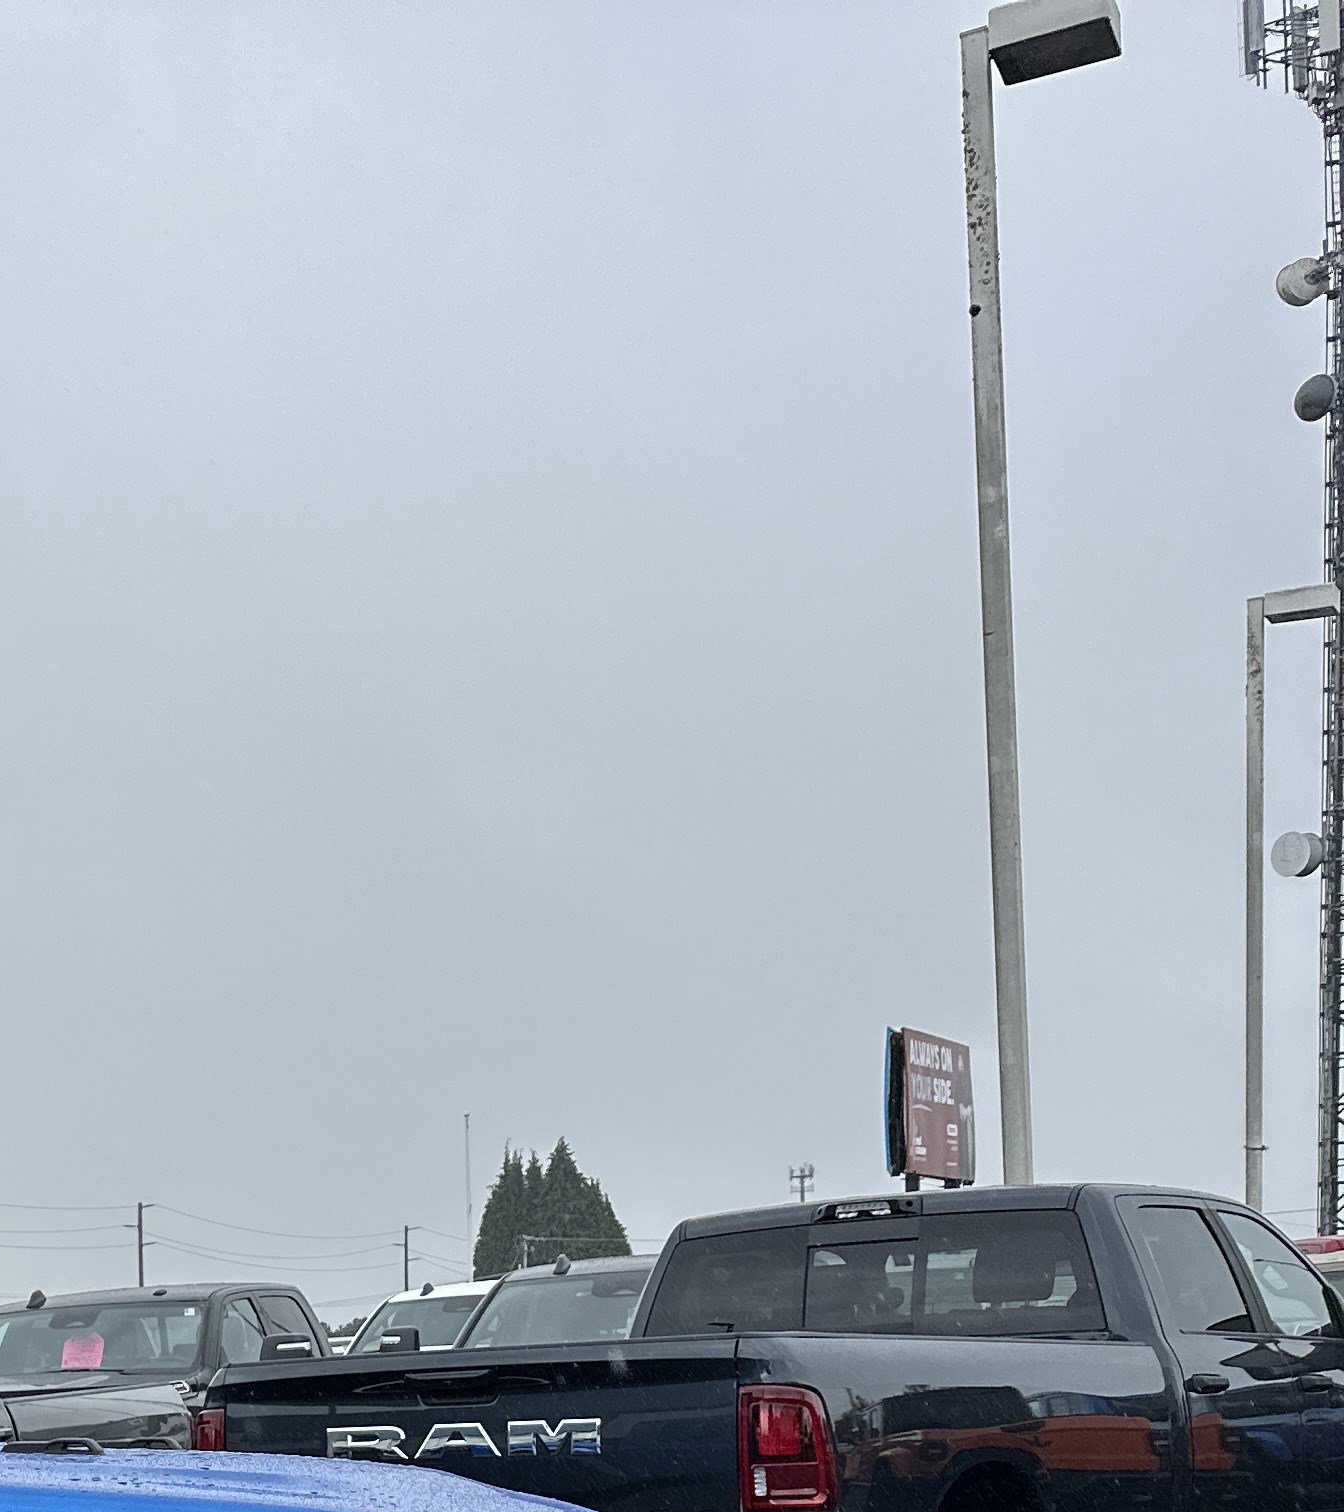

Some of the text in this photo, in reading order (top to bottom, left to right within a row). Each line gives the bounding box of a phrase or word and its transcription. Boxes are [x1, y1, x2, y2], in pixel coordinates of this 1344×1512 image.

[909, 1038, 953, 1073] ALWAYS ON
[325, 1417, 602, 1459] RAM
